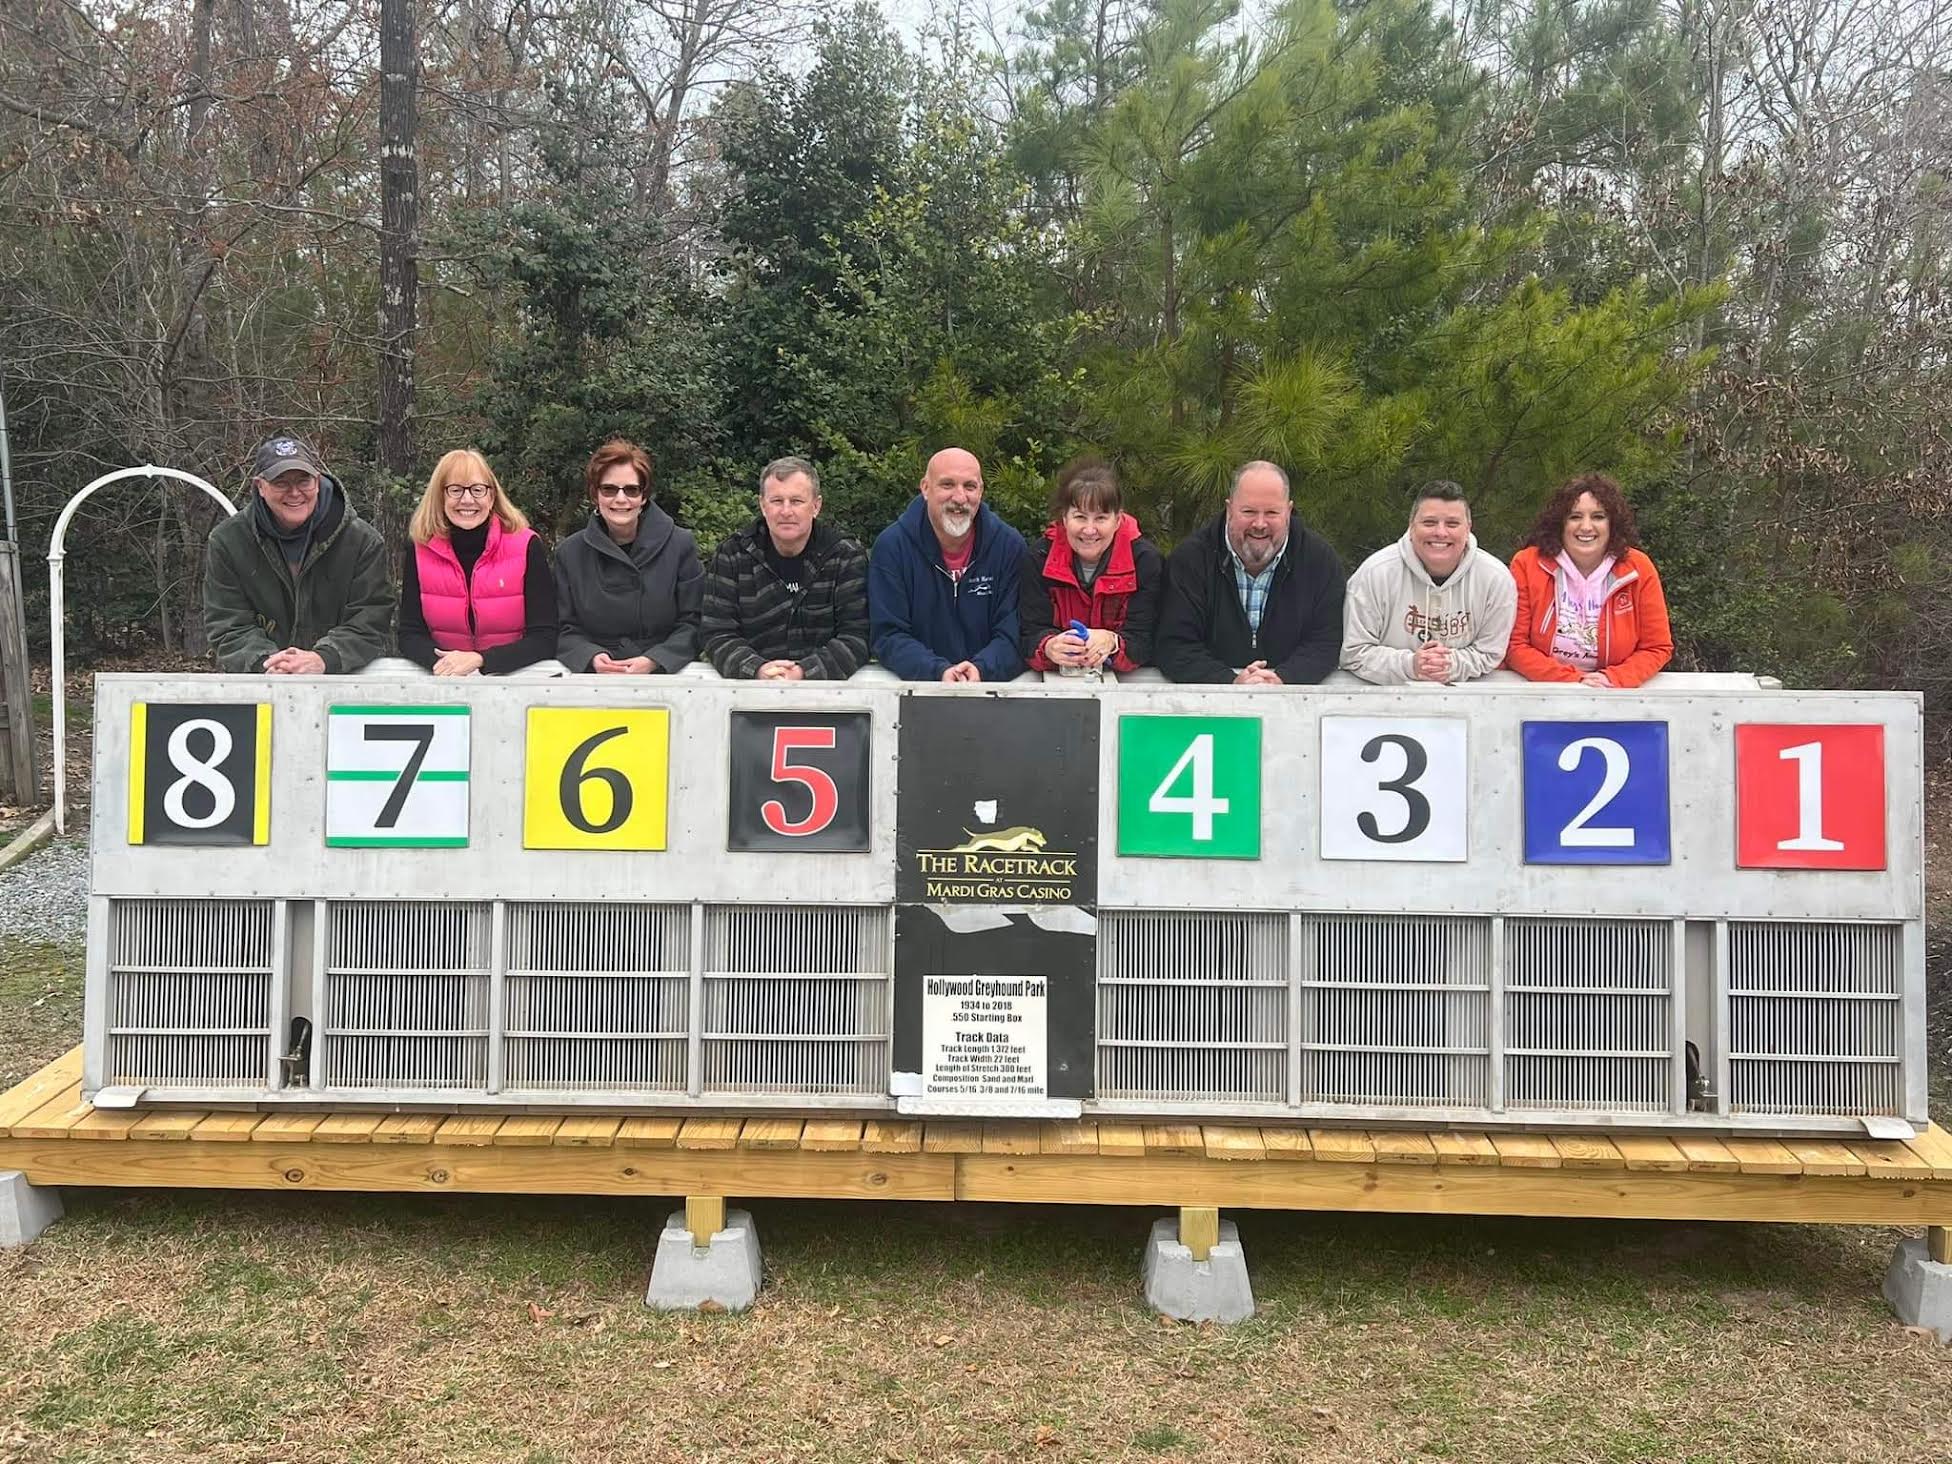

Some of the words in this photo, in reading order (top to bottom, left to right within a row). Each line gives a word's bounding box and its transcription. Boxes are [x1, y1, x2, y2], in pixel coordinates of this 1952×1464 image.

[162, 718, 236, 829] 8
[363, 723, 436, 829] 7
[558, 725, 635, 834] 6
[759, 726, 840, 837] 5
[1148, 733, 1229, 840] 4
[1355, 733, 1431, 844] 3
[1557, 737, 1636, 847] 2
[1777, 741, 1845, 851] 1
[916, 854, 957, 873] THE
[964, 854, 1077, 876] RACETRACK
[927, 883, 974, 897] MARDI
[977, 884, 1014, 898] GRAS
[1017, 885, 1071, 899] CASINO
[927, 979, 973, 997] Hollywood
[976, 979, 1023, 997] Greyhound
[1025, 980, 1045, 997] Park
[961, 1001, 980, 1009] 1934
[982, 1001, 990, 1010] to
[992, 1001, 1012, 1010] 2018
[971, 1013, 1005, 1023] Starting
[1007, 1014, 1022, 1022] Box
[956, 1032, 984, 1042] Track
[986, 1032, 1009, 1042] Data
[941, 1044, 962, 1052] Track
[964, 1045, 989, 1053] Length
[948, 1054, 969, 1062] Track
[994, 1055, 1003, 1063] 22
[936, 1064, 961, 1072] Length
[927, 1085, 958, 1093] Courses
[1027, 1086, 1044, 1094] mile
